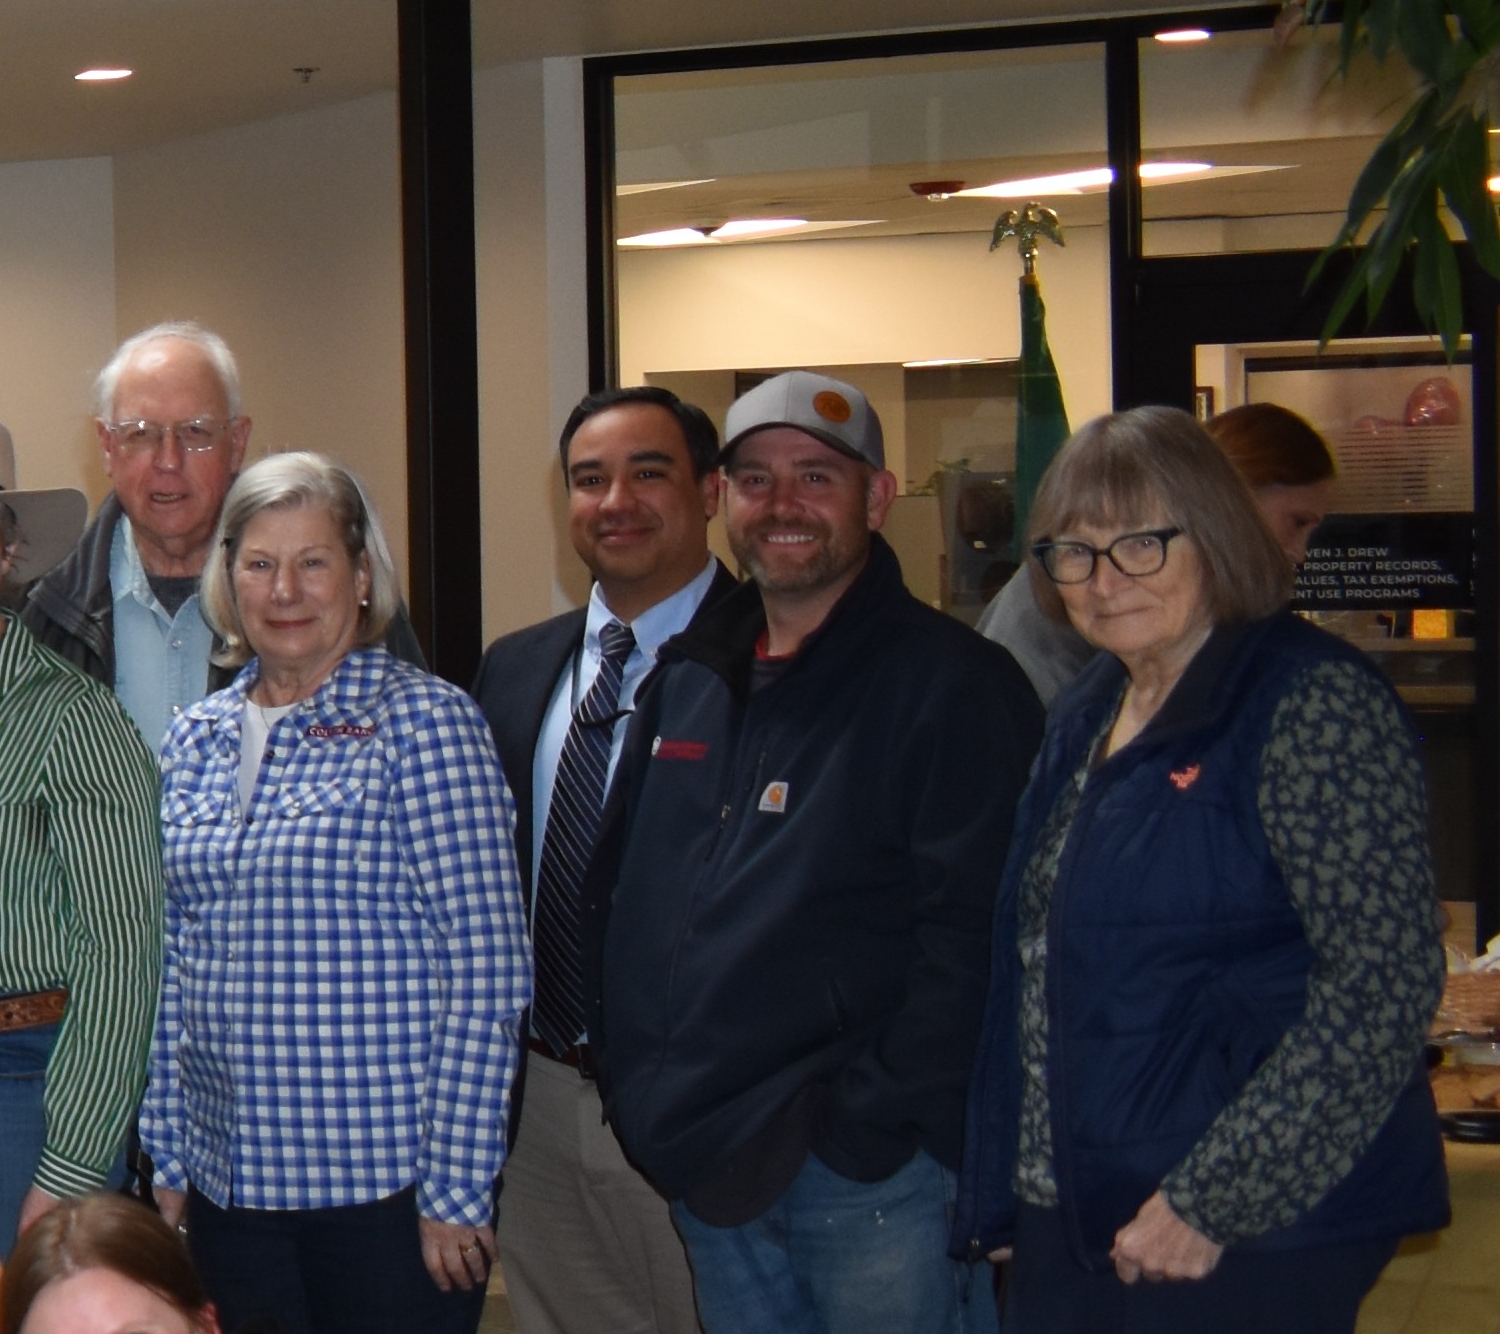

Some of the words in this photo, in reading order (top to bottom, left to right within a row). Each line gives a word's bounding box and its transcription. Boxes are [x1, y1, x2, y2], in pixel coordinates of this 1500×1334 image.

[1347, 547, 1389, 558] DREW
[1303, 561, 1372, 572] PROPERTY
[1375, 560, 1443, 572] RECORDS,
[1294, 575, 1340, 586] ALUES,
[1343, 575, 1367, 585] TAX
[1370, 574, 1459, 586] EXEMPTIONS,
[1316, 589, 1342, 600] USE
[1345, 588, 1421, 599] PROGRAMS
